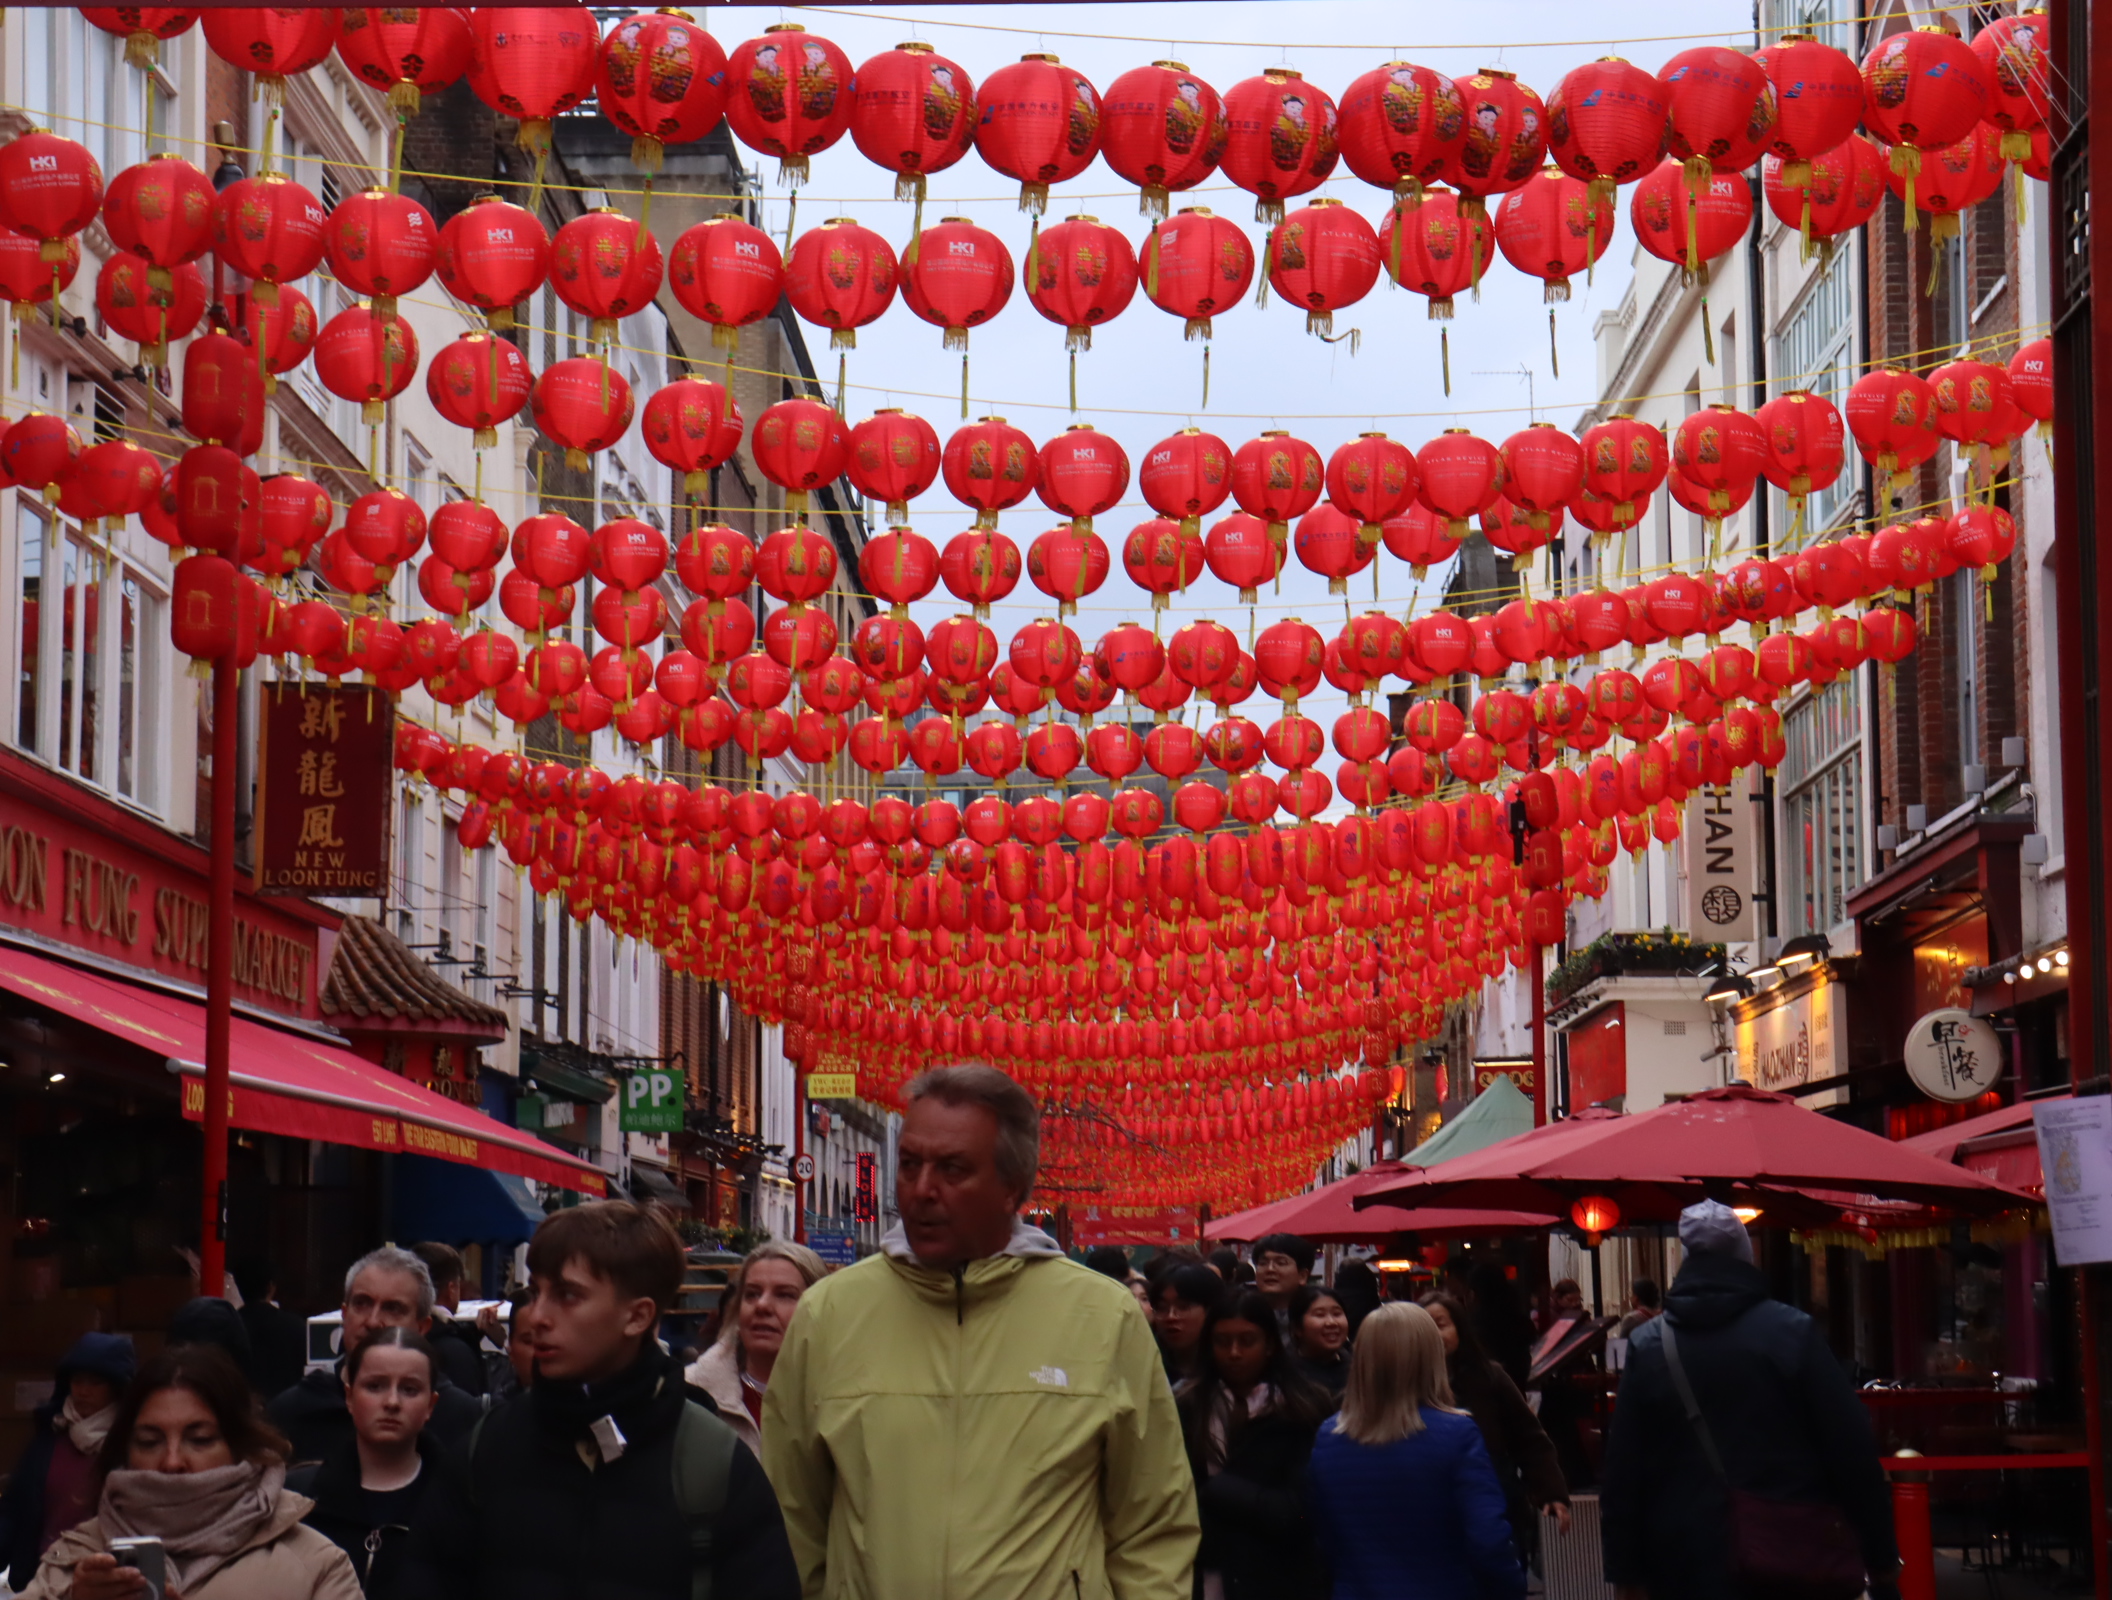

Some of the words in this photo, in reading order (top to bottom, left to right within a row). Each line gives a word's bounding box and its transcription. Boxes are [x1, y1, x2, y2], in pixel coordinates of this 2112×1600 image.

[29, 155, 57, 169] HKI
[487, 228, 514, 241] HKI
[735, 241, 760, 256] HKI
[949, 241, 975, 255] HKI
[2025, 360, 2044, 371] HKI
[1073, 448, 1096, 460] HKI
[627, 533, 646, 543] HKI
[297, 695, 346, 848] 新龍鳳
[295, 851, 345, 869] NEW
[265, 870, 319, 887] LOON
[324, 870, 376, 887] FUNG
[63, 847, 141, 946] FUNG
[153, 886, 312, 1005] SUPMARKET
[799, 1161, 813, 1174] 20
[861, 1158, 870, 1216] SLOTS
